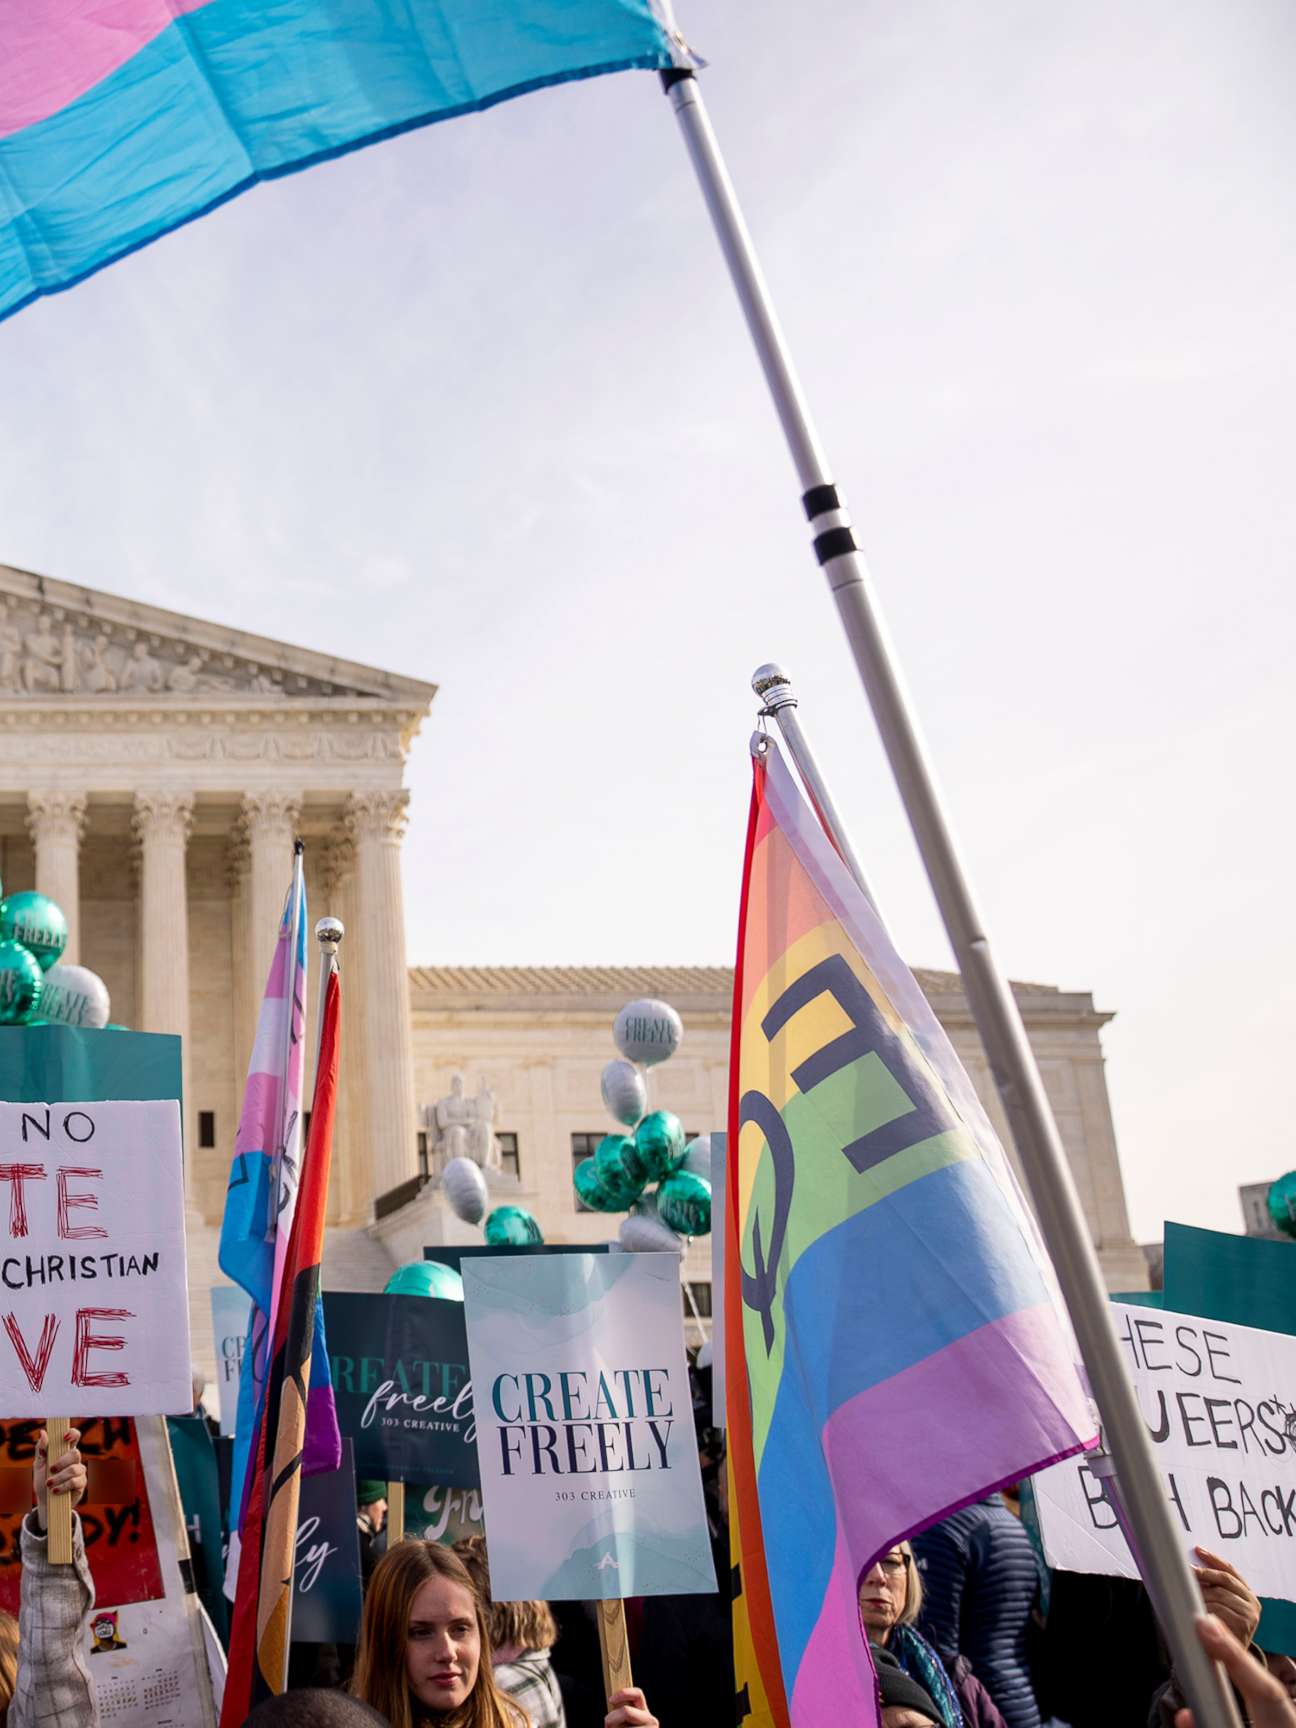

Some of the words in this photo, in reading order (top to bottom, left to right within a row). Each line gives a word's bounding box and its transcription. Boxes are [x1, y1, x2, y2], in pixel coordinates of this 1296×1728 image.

[21, 1110, 96, 1143] NO
[1, 1252, 160, 1290] CHRISTIAN
[1120, 1313, 1242, 1385] HESE
[330, 1353, 470, 1401] REATE
[491, 1368, 674, 1424] CREATE
[380, 1416, 400, 1428] 303
[403, 1417, 461, 1434] CREATIVE
[1134, 1385, 1287, 1457] UEERS
[496, 1419, 675, 1476] FREELY
[554, 1491, 576, 1502] 303
[580, 1488, 637, 1502] CREATIVE
